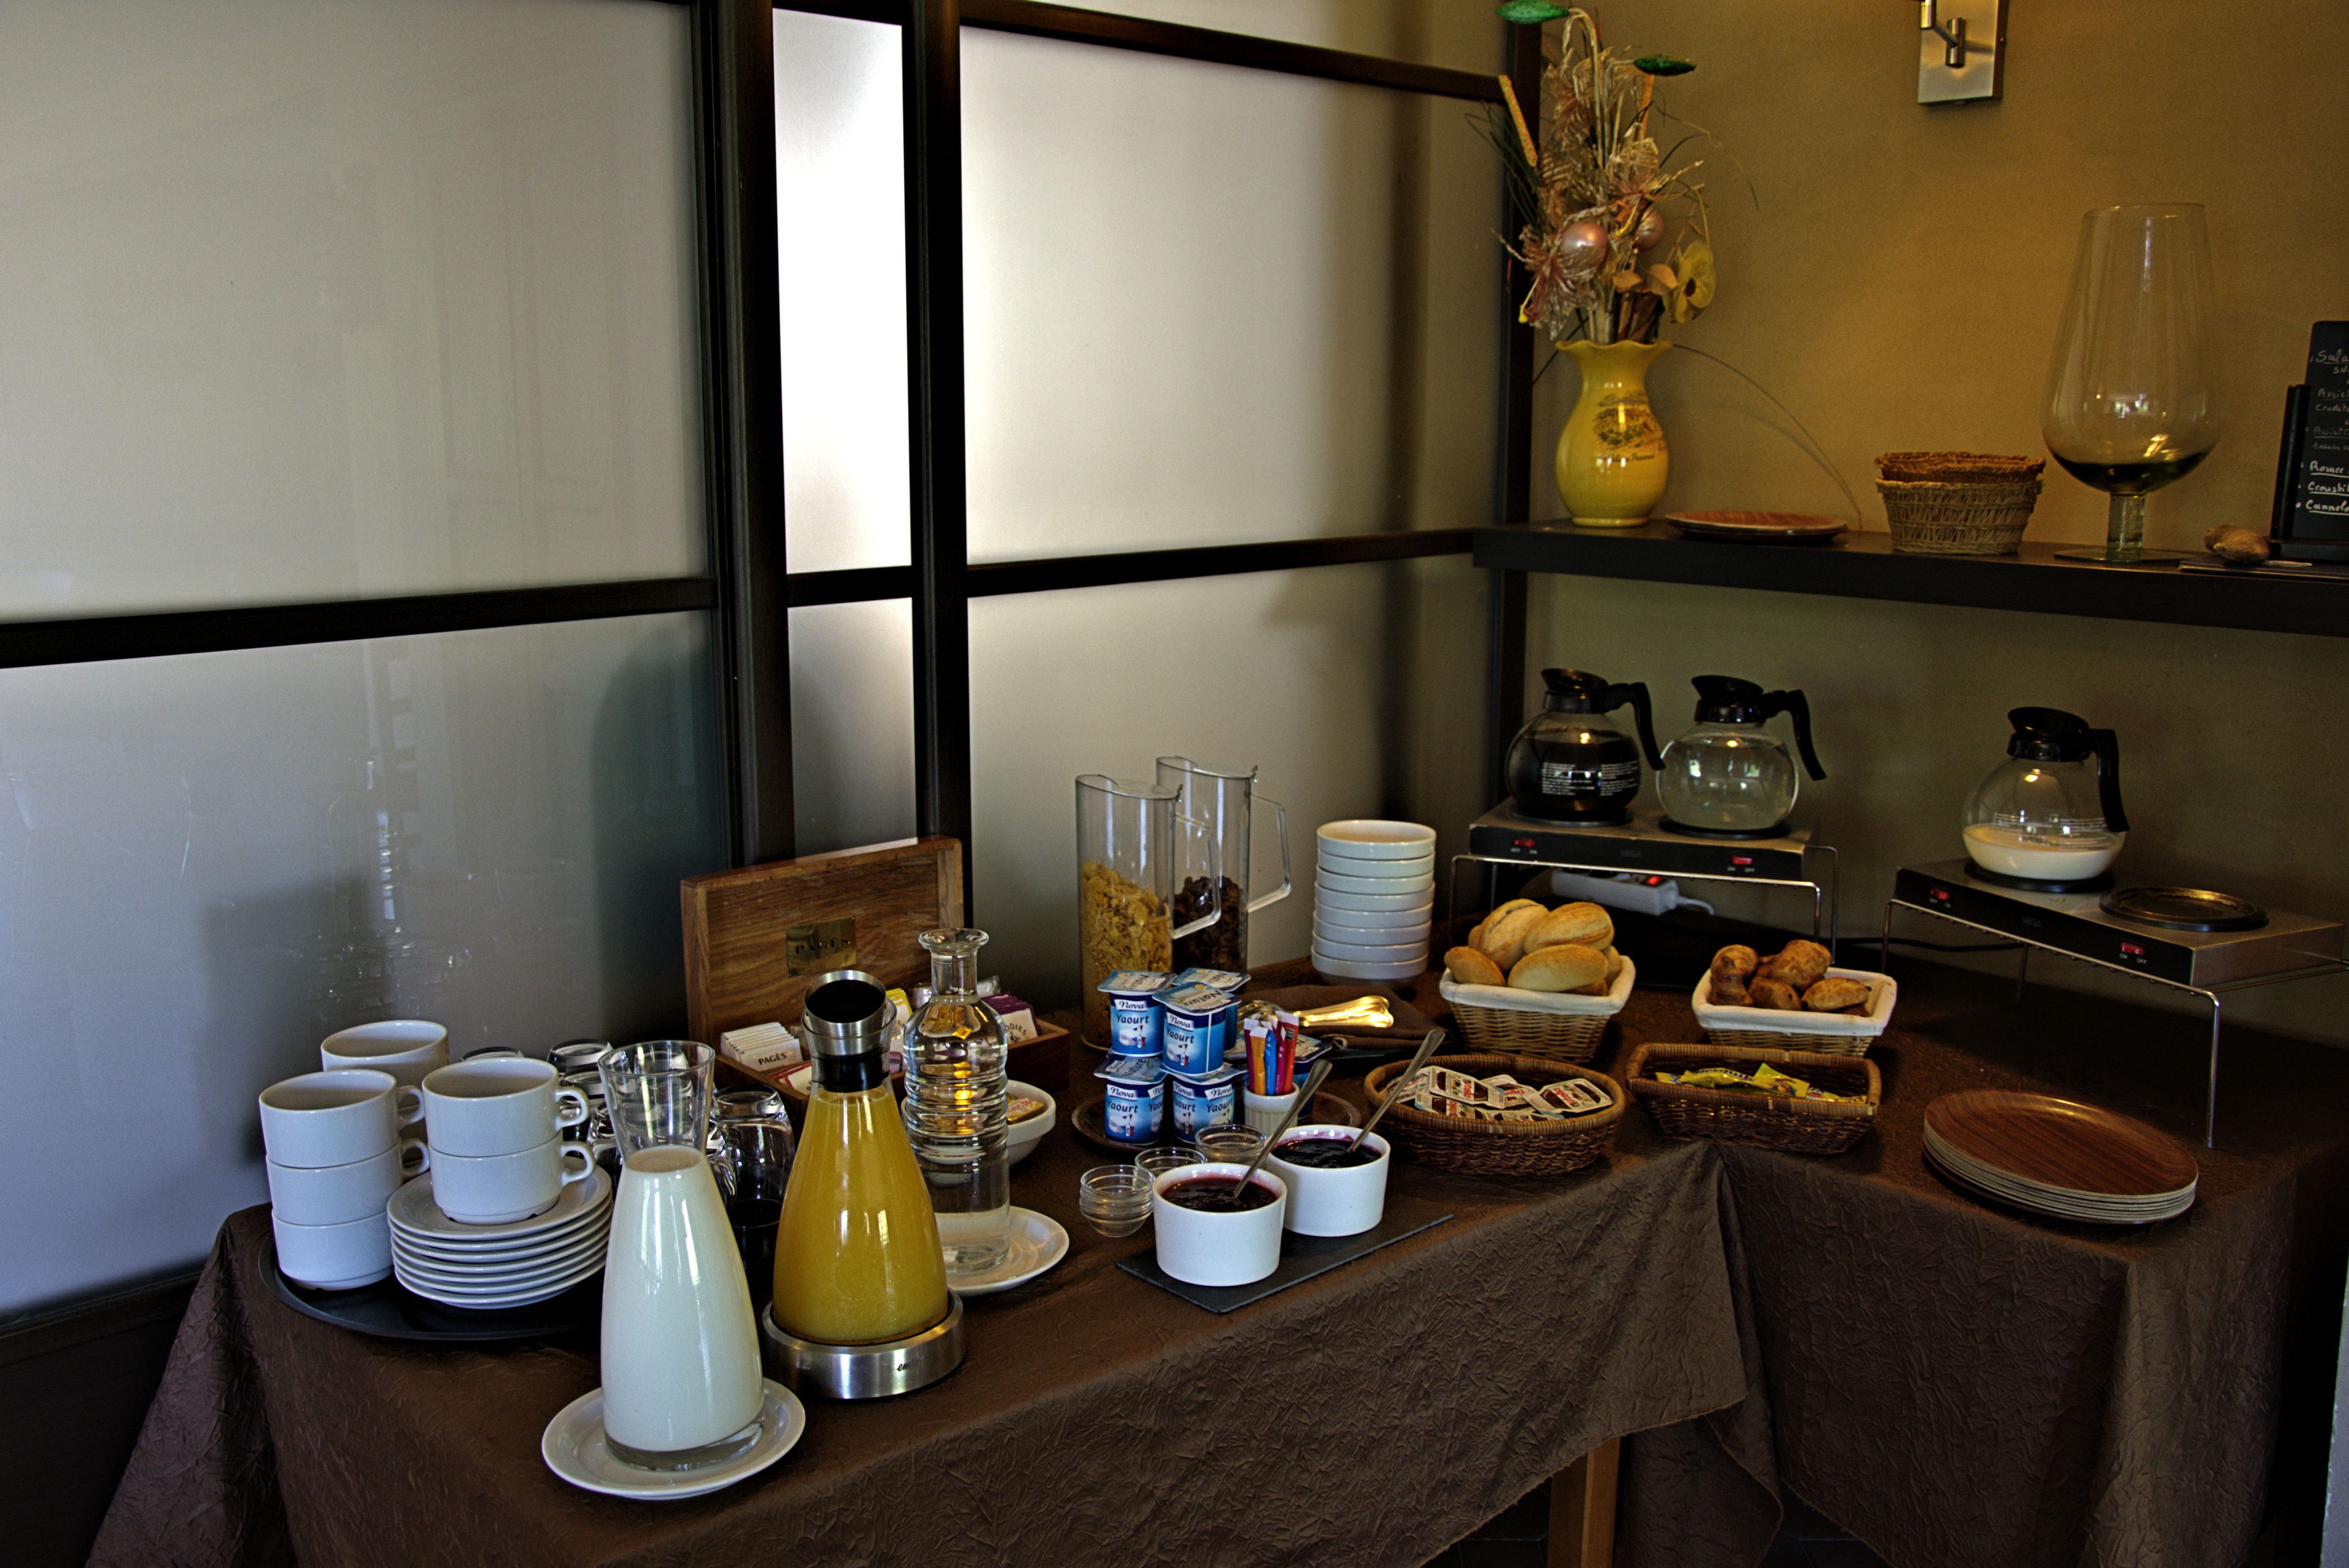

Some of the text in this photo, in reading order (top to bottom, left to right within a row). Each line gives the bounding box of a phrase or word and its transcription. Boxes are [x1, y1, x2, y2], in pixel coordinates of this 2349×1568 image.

[1119, 1000, 1145, 1009] Nova
[1182, 990, 1222, 1006] Nature
[1116, 1013, 1149, 1024] Yaourt
[1169, 1014, 1191, 1028] Nova
[1005, 1023, 1027, 1036] ODIES
[1166, 1028, 1195, 1044] Yaourt
[758, 1052, 787, 1065] PAGÈS
[1110, 1087, 1135, 1098] Nova
[1174, 1082, 1192, 1096] Nova
[1210, 1086, 1232, 1098] Nova
[1553, 1087, 1579, 1107] nutella
[1107, 1099, 1139, 1113] Yaourt
[1206, 1098, 1233, 1113] Yaourt
